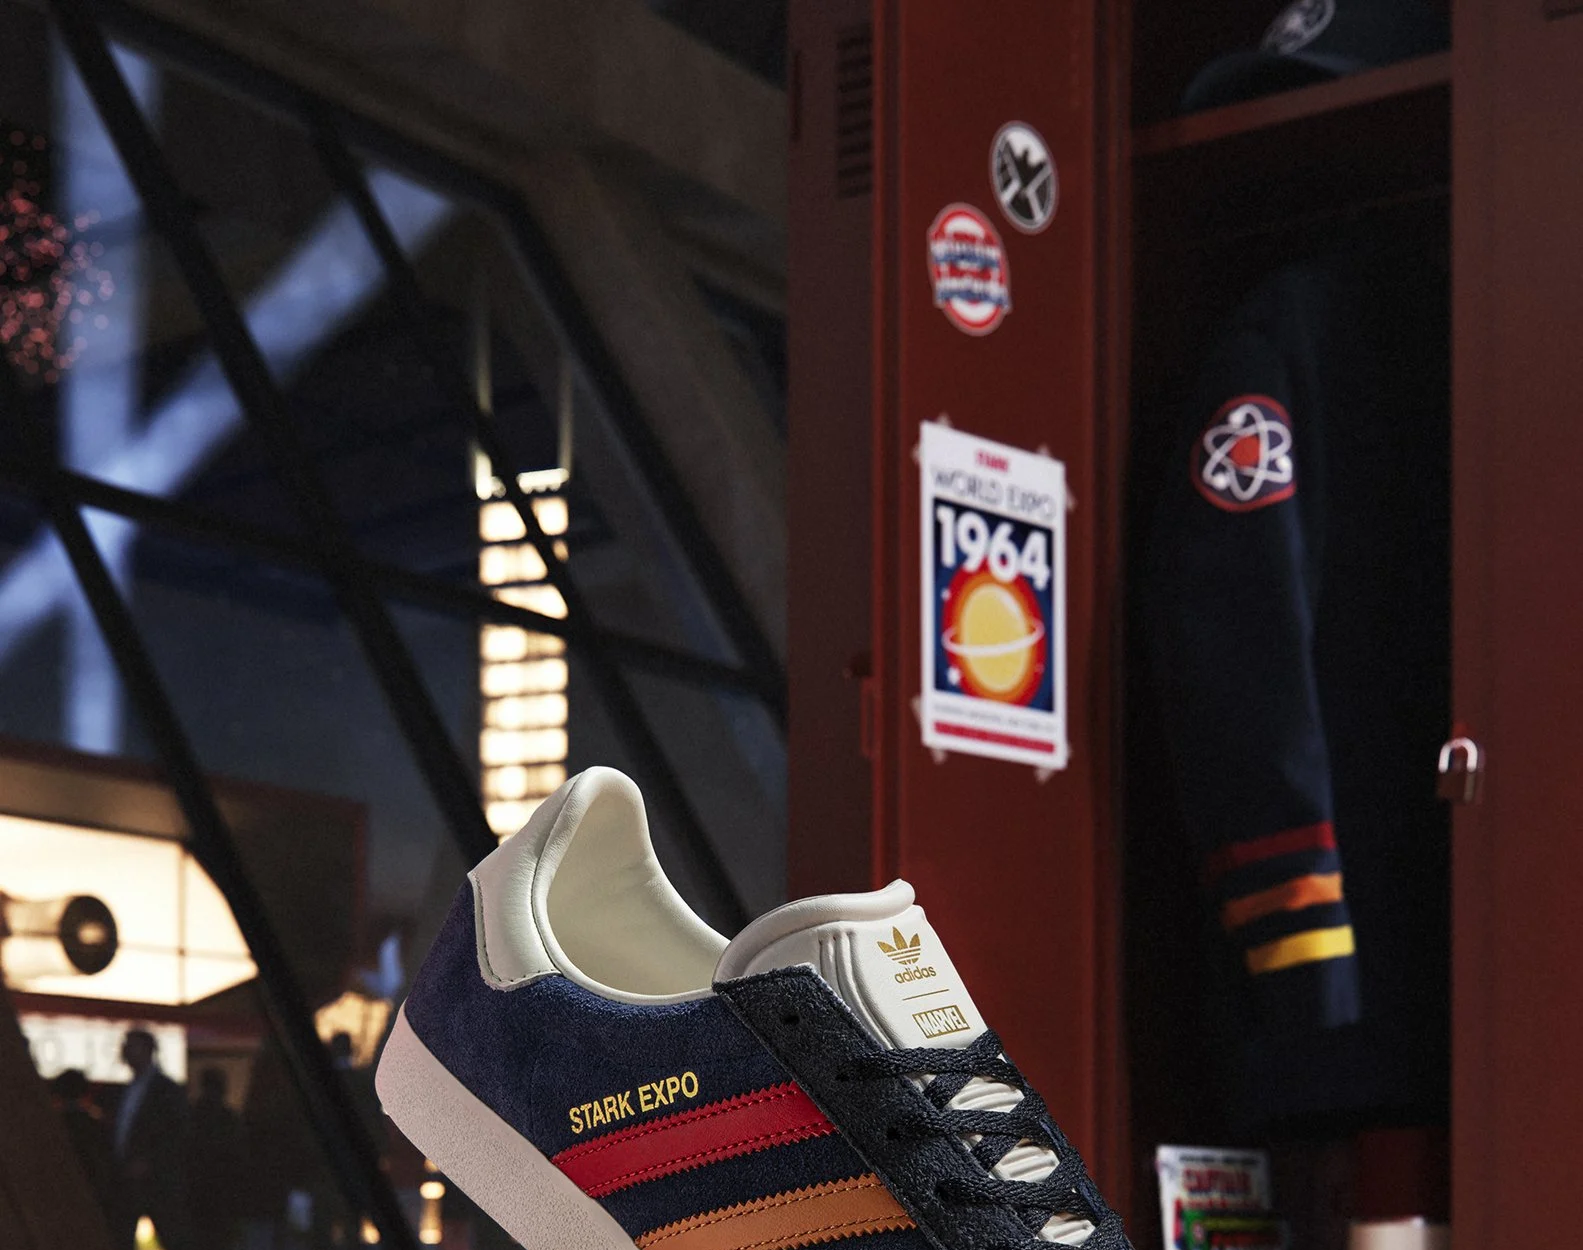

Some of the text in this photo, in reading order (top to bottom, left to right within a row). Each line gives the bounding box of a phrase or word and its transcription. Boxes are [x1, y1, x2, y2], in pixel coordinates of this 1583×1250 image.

[936, 505, 1050, 591] 1964
[894, 966, 937, 984] adidas
[912, 1005, 970, 1039] MARVEL
[569, 1071, 699, 1134] STARK EXPO
